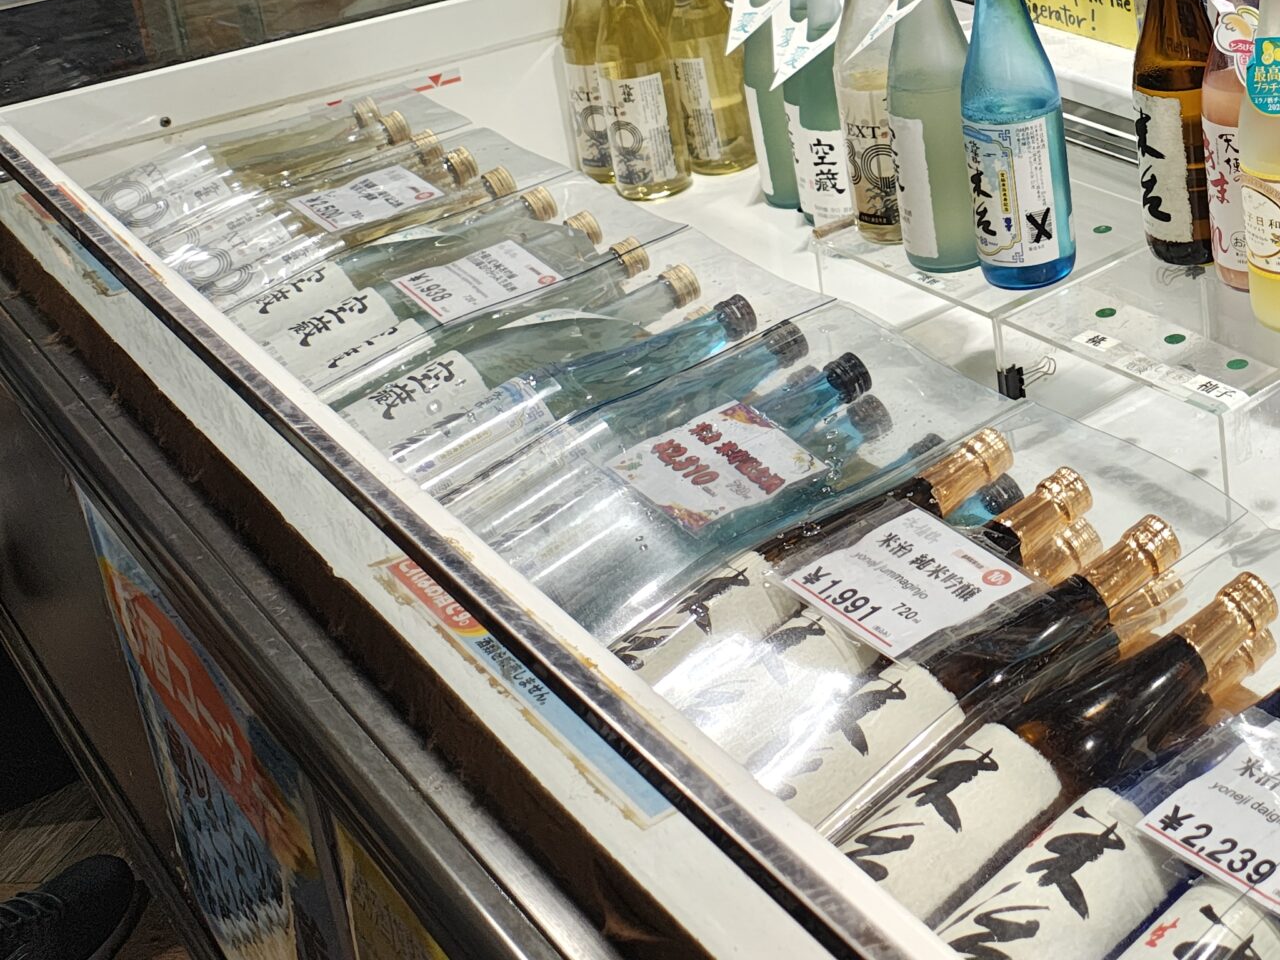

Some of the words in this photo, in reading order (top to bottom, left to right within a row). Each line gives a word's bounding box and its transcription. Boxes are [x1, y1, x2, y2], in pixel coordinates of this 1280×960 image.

[810, 138, 846, 196] 空蔵
[801, 565, 884, 623] ¥1,991
[876, 531, 914, 559] 米治
[908, 552, 984, 604] 純米吟醸
[1208, 780, 1250, 810] yoneji
[1158, 803, 1277, 885] ¥2,239
